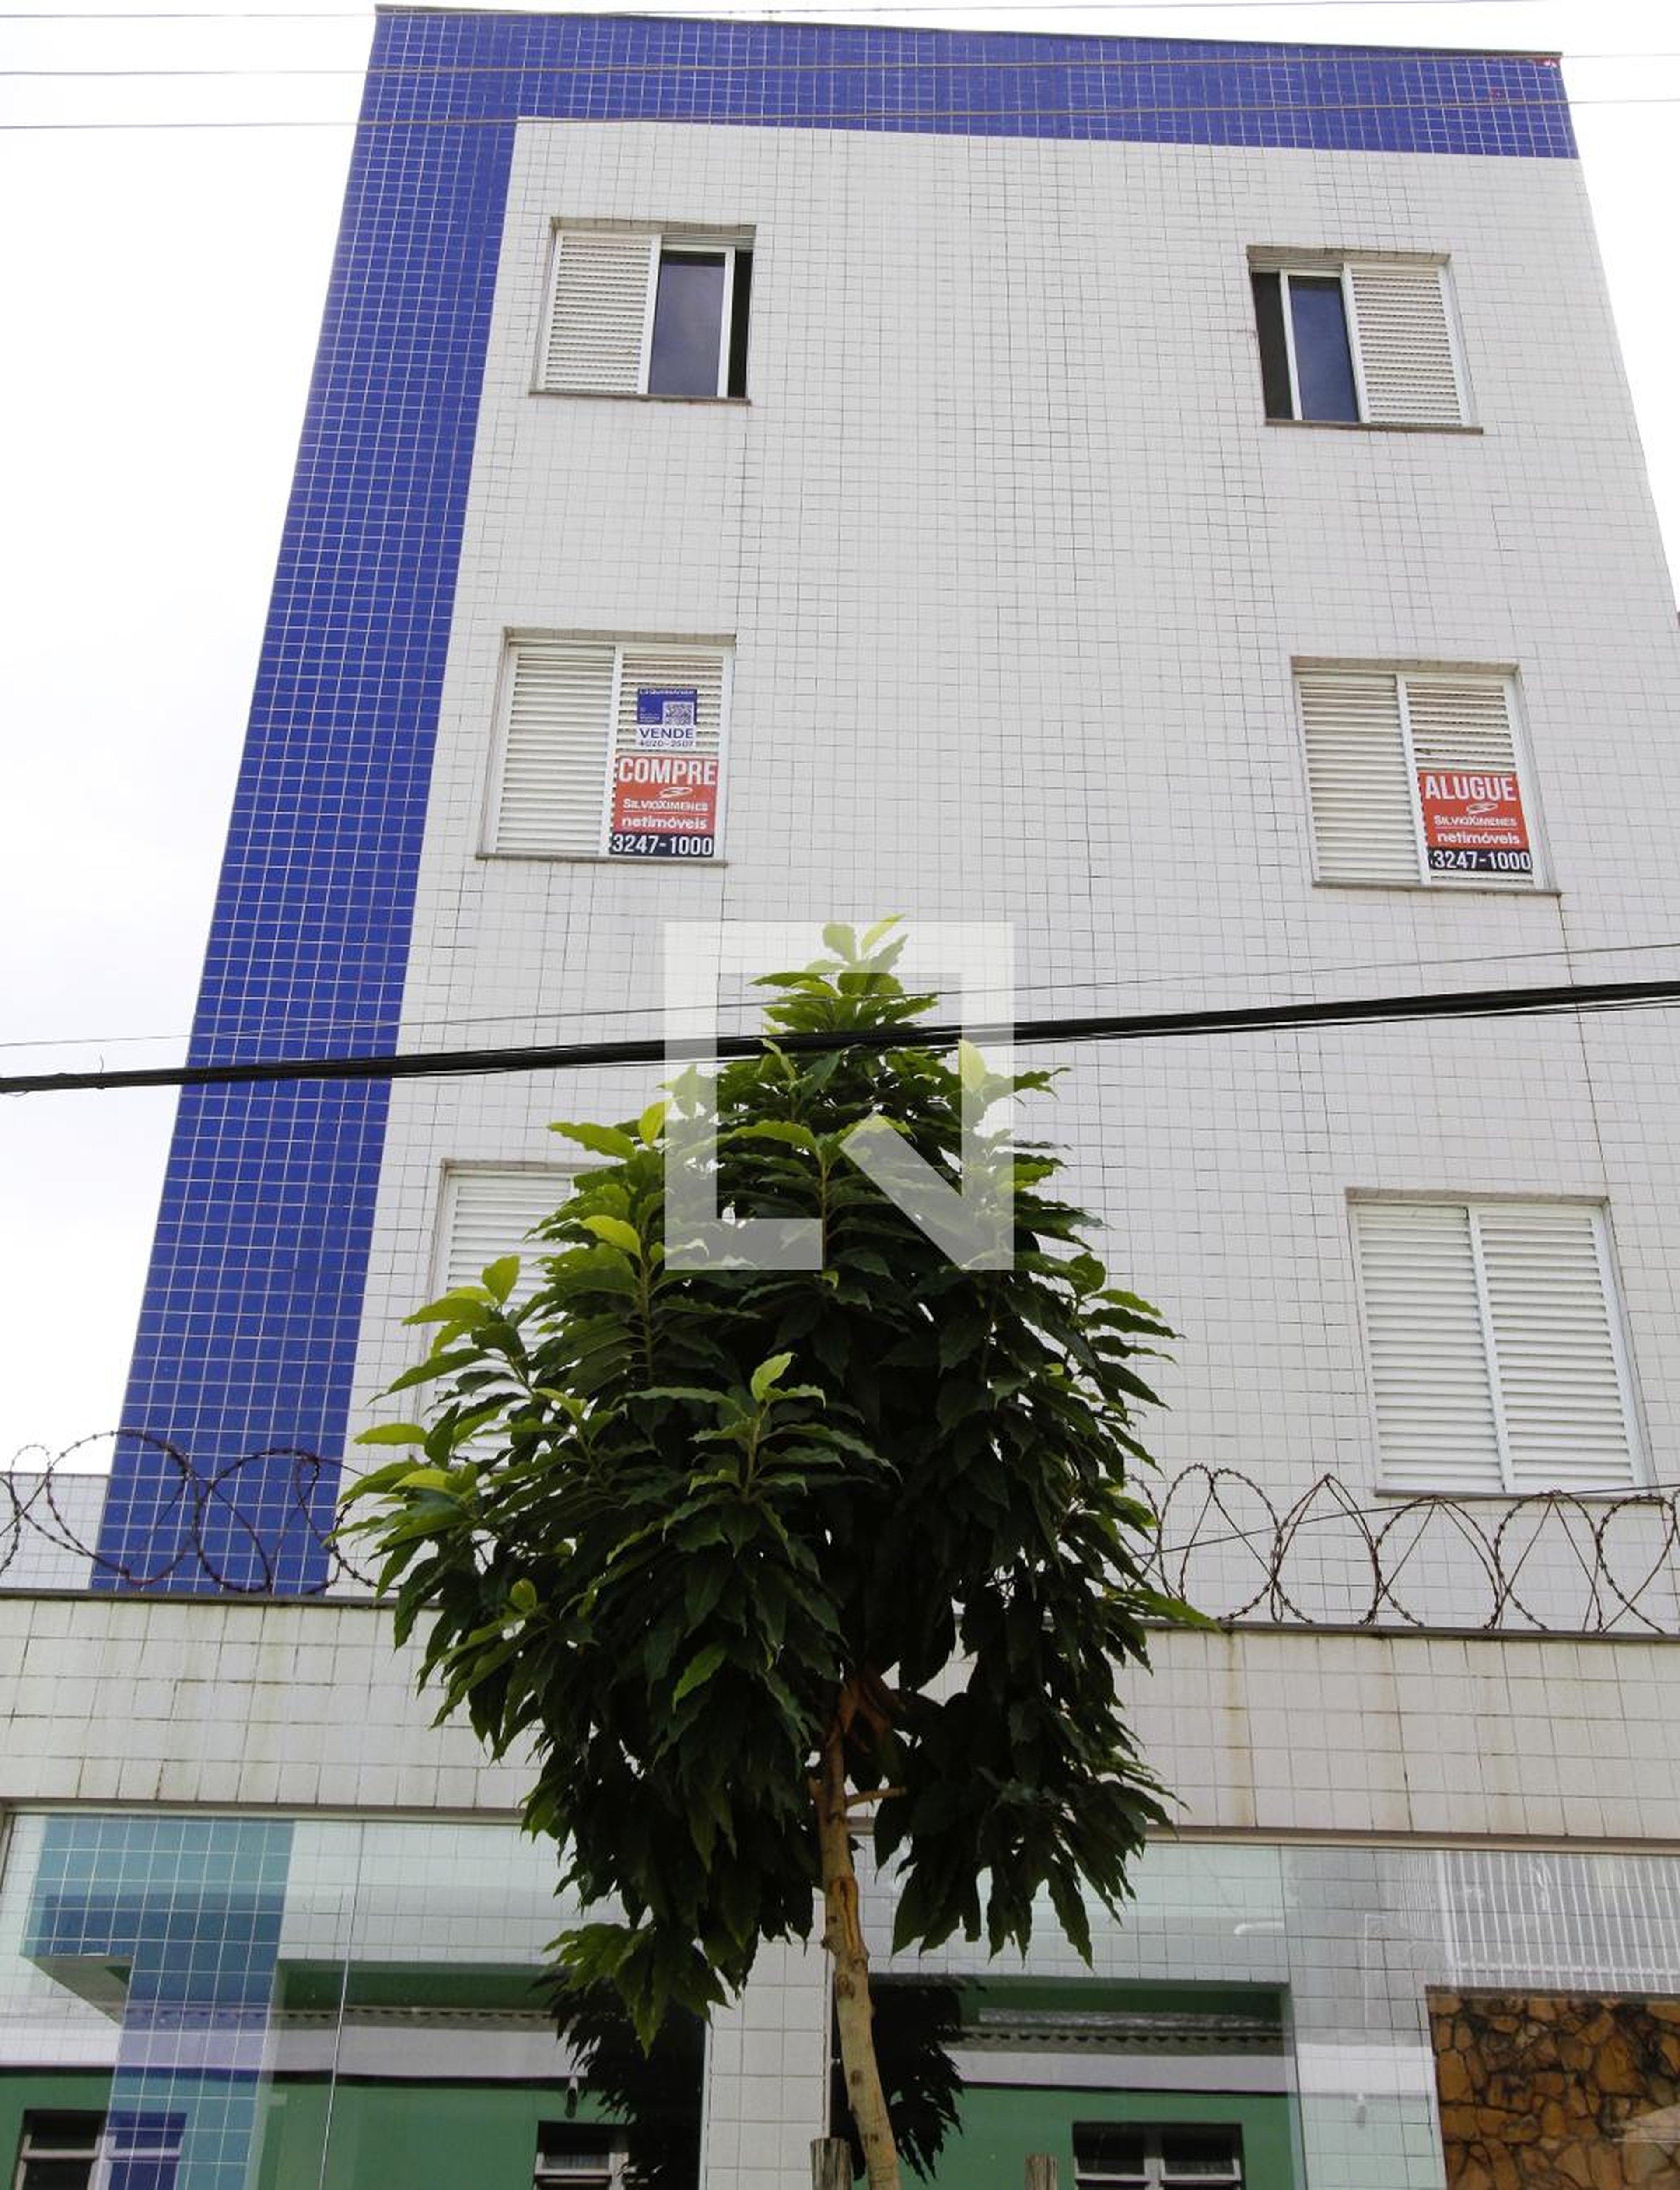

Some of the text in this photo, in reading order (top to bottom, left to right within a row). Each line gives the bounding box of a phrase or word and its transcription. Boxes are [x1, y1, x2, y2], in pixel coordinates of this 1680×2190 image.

[639, 728, 693, 738] VENDE
[619, 757, 717, 785] COMPRE
[1425, 775, 1517, 801] ALUGUE
[613, 834, 713, 856] 3247-1000
[1433, 850, 1531, 870] 3247-1000
